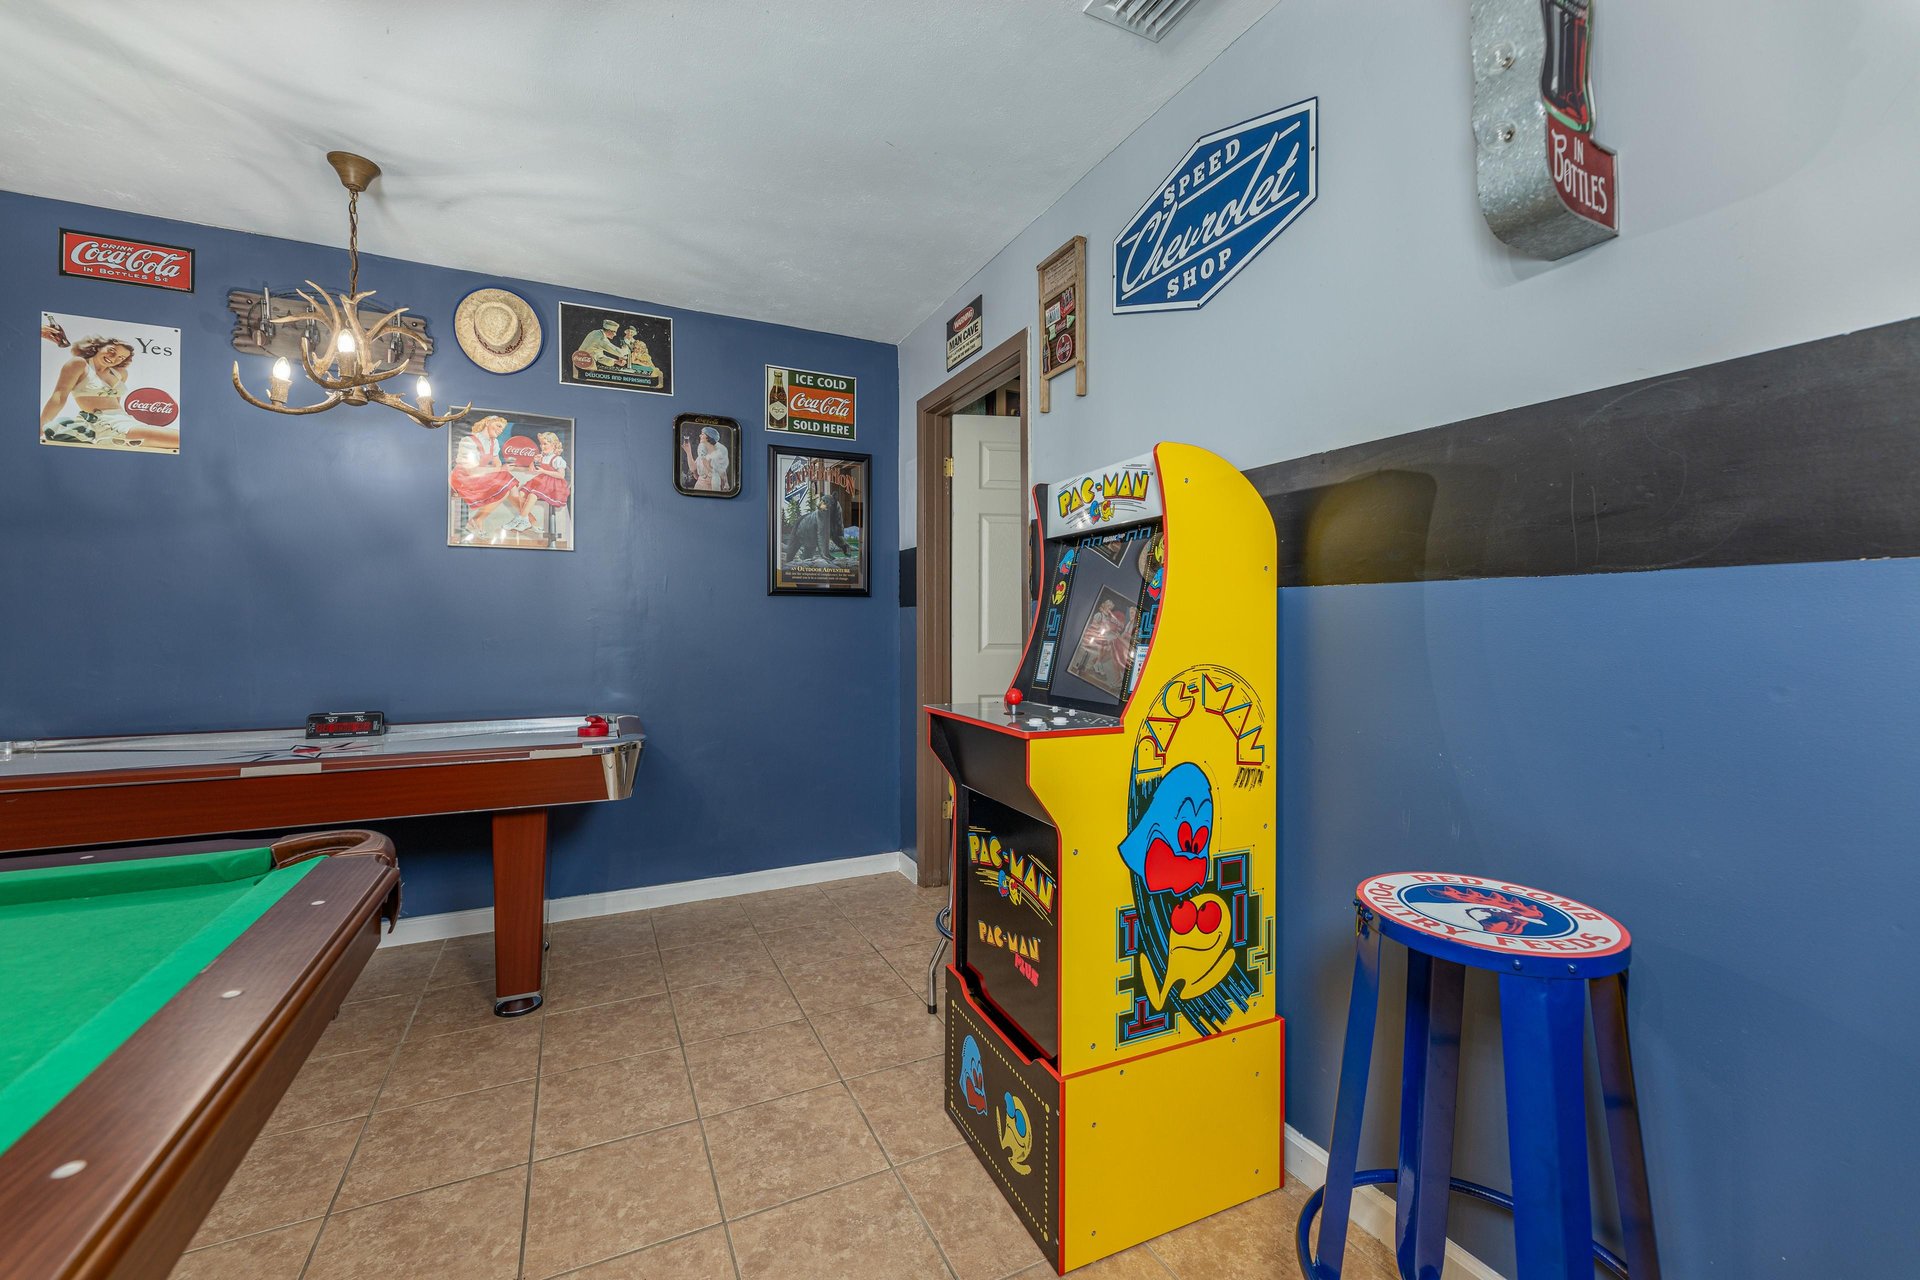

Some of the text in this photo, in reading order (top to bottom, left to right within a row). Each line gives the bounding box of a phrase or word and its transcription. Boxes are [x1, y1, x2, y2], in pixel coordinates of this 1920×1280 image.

[1573, 136, 1584, 165] IN
[1163, 138, 1241, 208] SPEED
[1551, 129, 1608, 215] BOTTLES
[1121, 131, 1300, 292] Chevrolet
[70, 241, 186, 278] Coca-Cola
[101, 243, 134, 252] DRINK
[99, 268, 148, 280] BOTTLES
[1167, 248, 1232, 300] SHOP
[135, 337, 173, 357] Yes
[949, 333, 963, 351] MAN
[963, 321, 979, 341] CAVE
[584, 372, 611, 380] DELICIOUS
[795, 373, 847, 390] ICE COLD
[789, 392, 851, 417] Coca-Cola
[793, 419, 850, 436] SOLD HERE
[1057, 470, 1150, 519] PAC-MAN
[1135, 672, 1265, 774] PAC-MAN
[968, 832, 1055, 913] PAC-MAN
[1368, 881, 1612, 951] POULTRY FEEDS
[1410, 874, 1604, 922] RED COMB
[977, 919, 1041, 963] PAC-MAN
